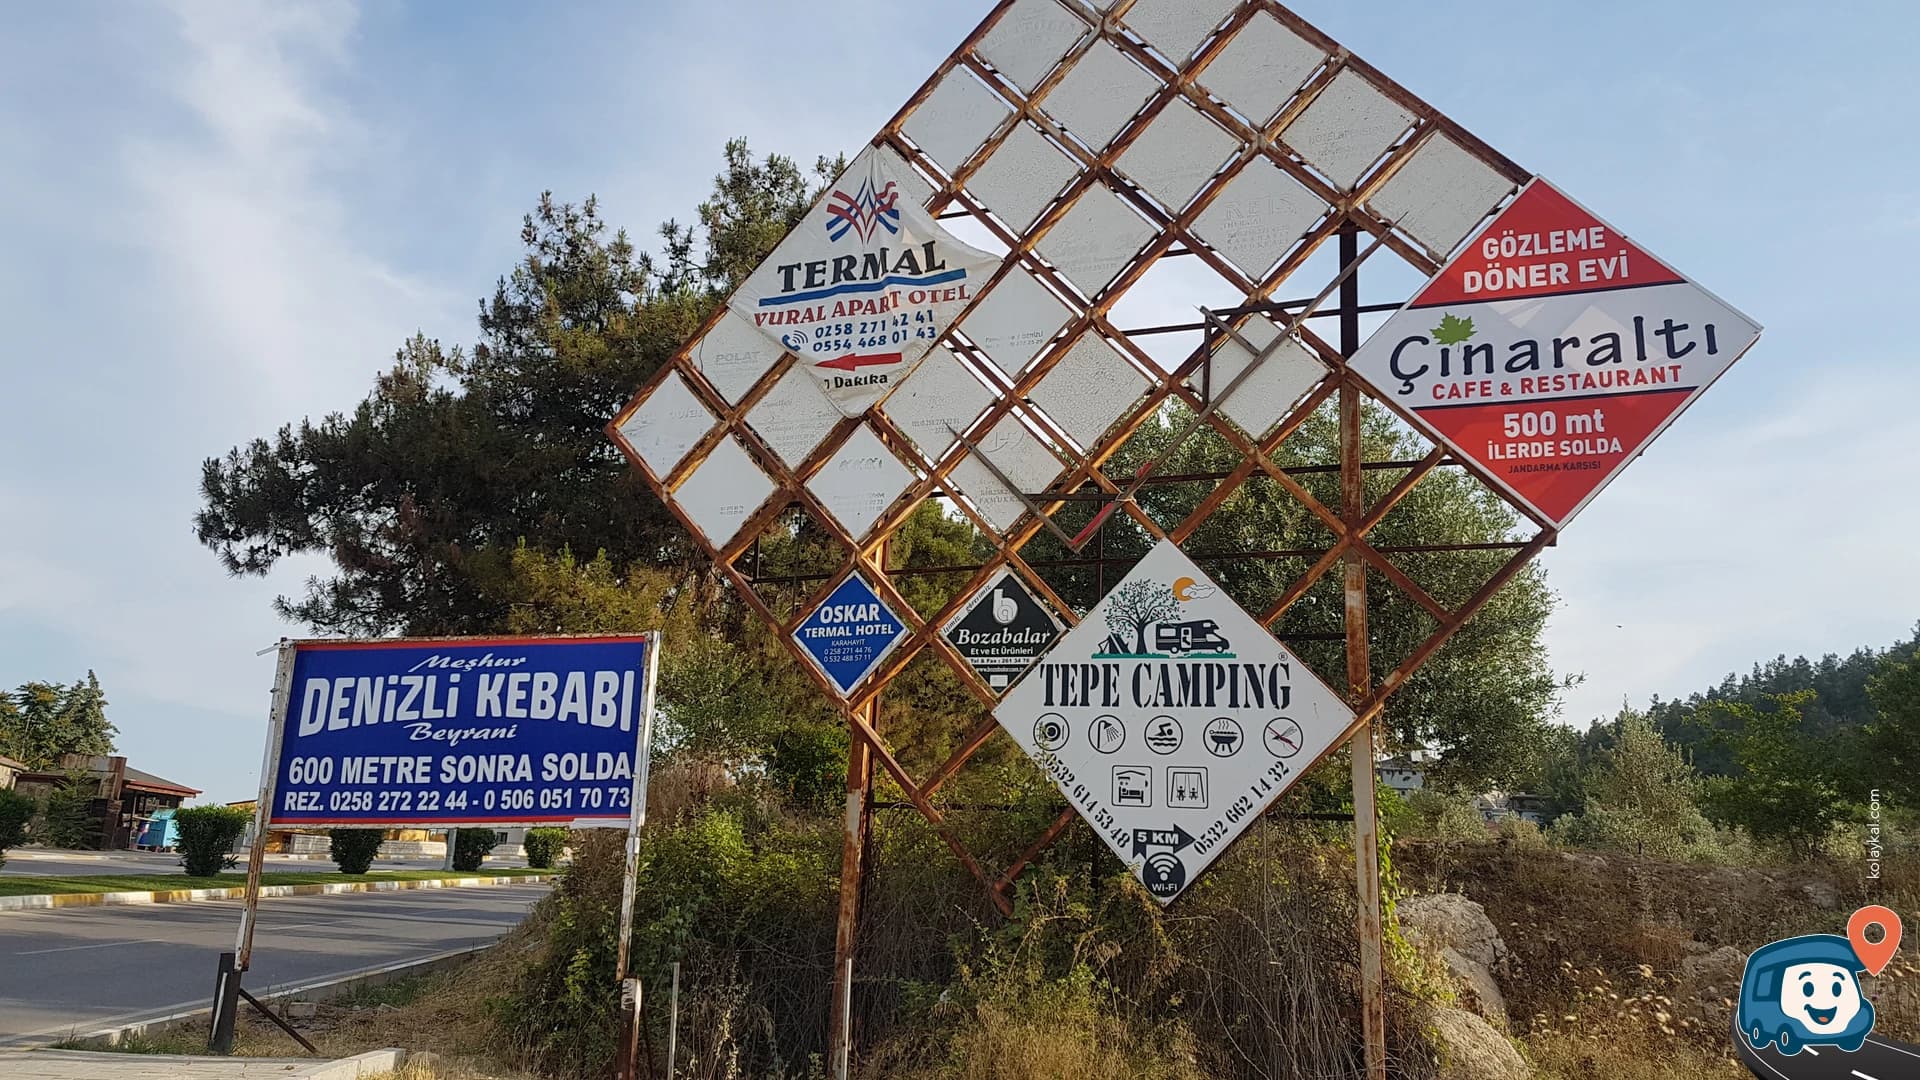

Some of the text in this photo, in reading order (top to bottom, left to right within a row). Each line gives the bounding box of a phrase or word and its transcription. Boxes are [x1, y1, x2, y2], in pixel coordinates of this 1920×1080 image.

[1482, 226, 1606, 261] GÖZLEME
[777, 241, 946, 293] TERMAL
[1463, 249, 1628, 294] DÖNER EVİ
[754, 284, 971, 327] VURAL APART OTEL
[815, 310, 933, 338] 0258 271 42 41
[813, 326, 936, 352] 0554 468 01 43
[1432, 365, 1683, 400] CAFE & RESTAURANT
[1503, 409, 1605, 438] 500 mt
[1560, 437, 1623, 456] SOLDA
[820, 603, 880, 624] OSKAR
[805, 624, 894, 638] TERMAL HOTEL
[956, 627, 1051, 645] Bozabalar
[408, 652, 527, 672] Meşhur
[970, 647, 979, 655] Et
[991, 647, 1000, 655] Et
[1000, 645, 1034, 655] Ürünleri
[1040, 662, 1292, 711] TEPE CAMPING
[476, 670, 635, 733] KEBABI
[403, 722, 518, 747] Beyrani
[288, 752, 632, 785] 600 METRE SONRA SOLDA
[284, 791, 324, 811] REZ.
[330, 791, 373, 811] 0258
[377, 790, 412, 811] 272
[416, 790, 440, 811] 22
[444, 790, 468, 810] 44
[484, 789, 495, 810] 0
[500, 788, 535, 810] 506
[540, 788, 572, 809] 051
[580, 787, 602, 808] 70
[608, 787, 630, 807] 73
[1045, 753, 1130, 848] 0532 614 53 48
[1193, 760, 1290, 855] 0532 662 14 32
[1137, 831, 1179, 845] 5 KM
